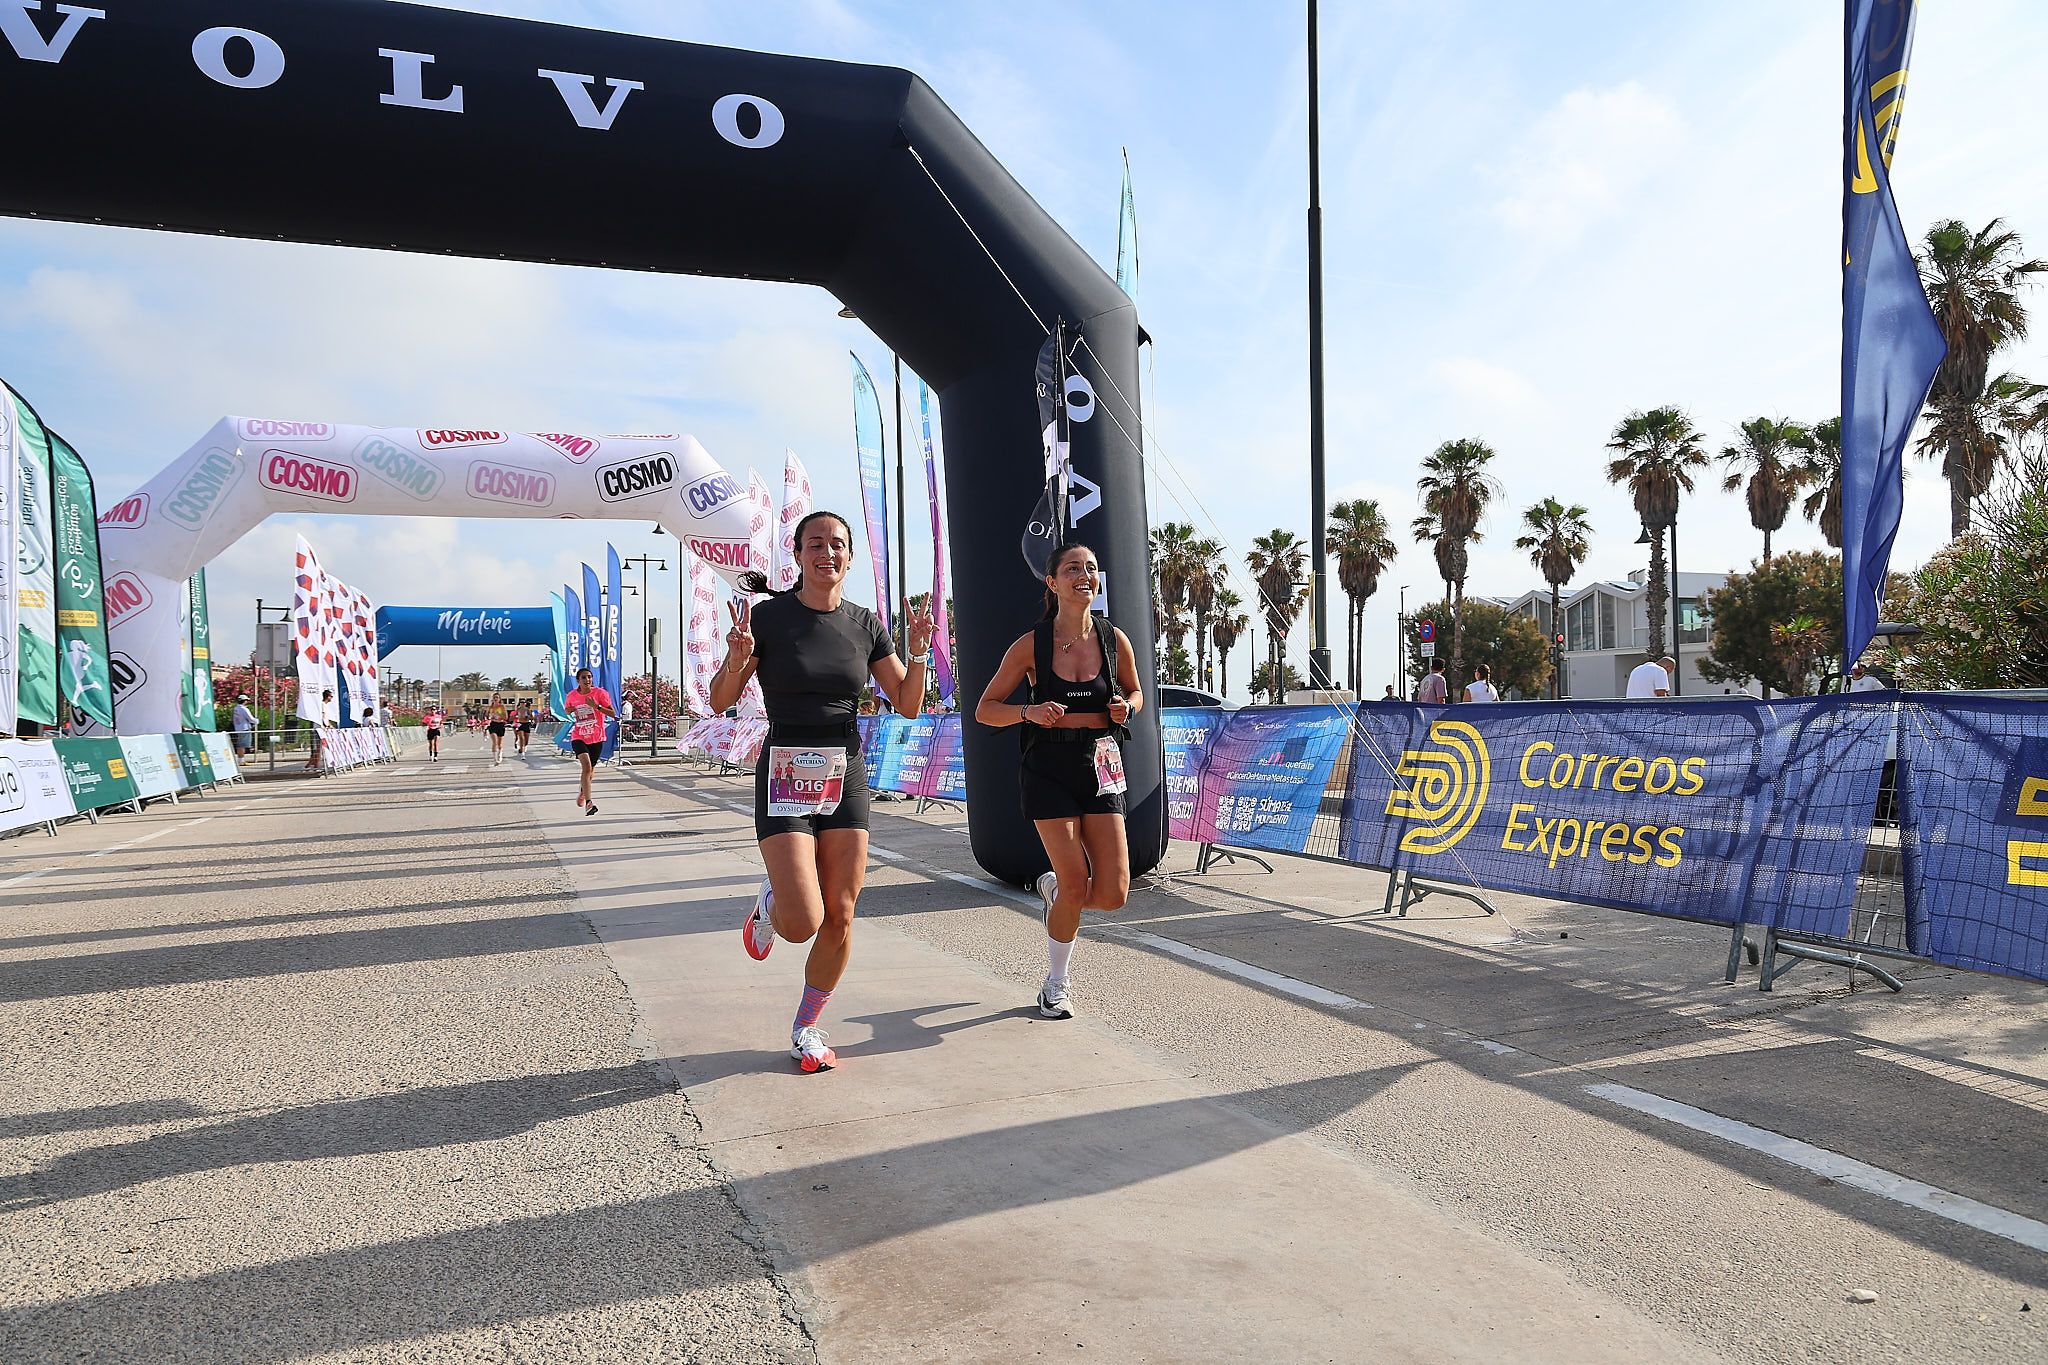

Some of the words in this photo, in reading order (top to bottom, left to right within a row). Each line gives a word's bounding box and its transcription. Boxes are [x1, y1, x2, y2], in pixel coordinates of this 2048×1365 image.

[0, 0, 785, 149] VOLVO
[169, 454, 236, 523] COSMO
[268, 455, 350, 497] COSMO
[362, 440, 438, 496] COSMO
[475, 466, 549, 503] COSMO
[603, 457, 673, 497] COSMO
[690, 538, 750, 568] COSMO
[437, 610, 512, 641] Marlene
[794, 780, 824, 792] 016
[1111, 763, 1121, 773] 01
[1519, 741, 1706, 797] Correos
[1501, 803, 1686, 869] Express
